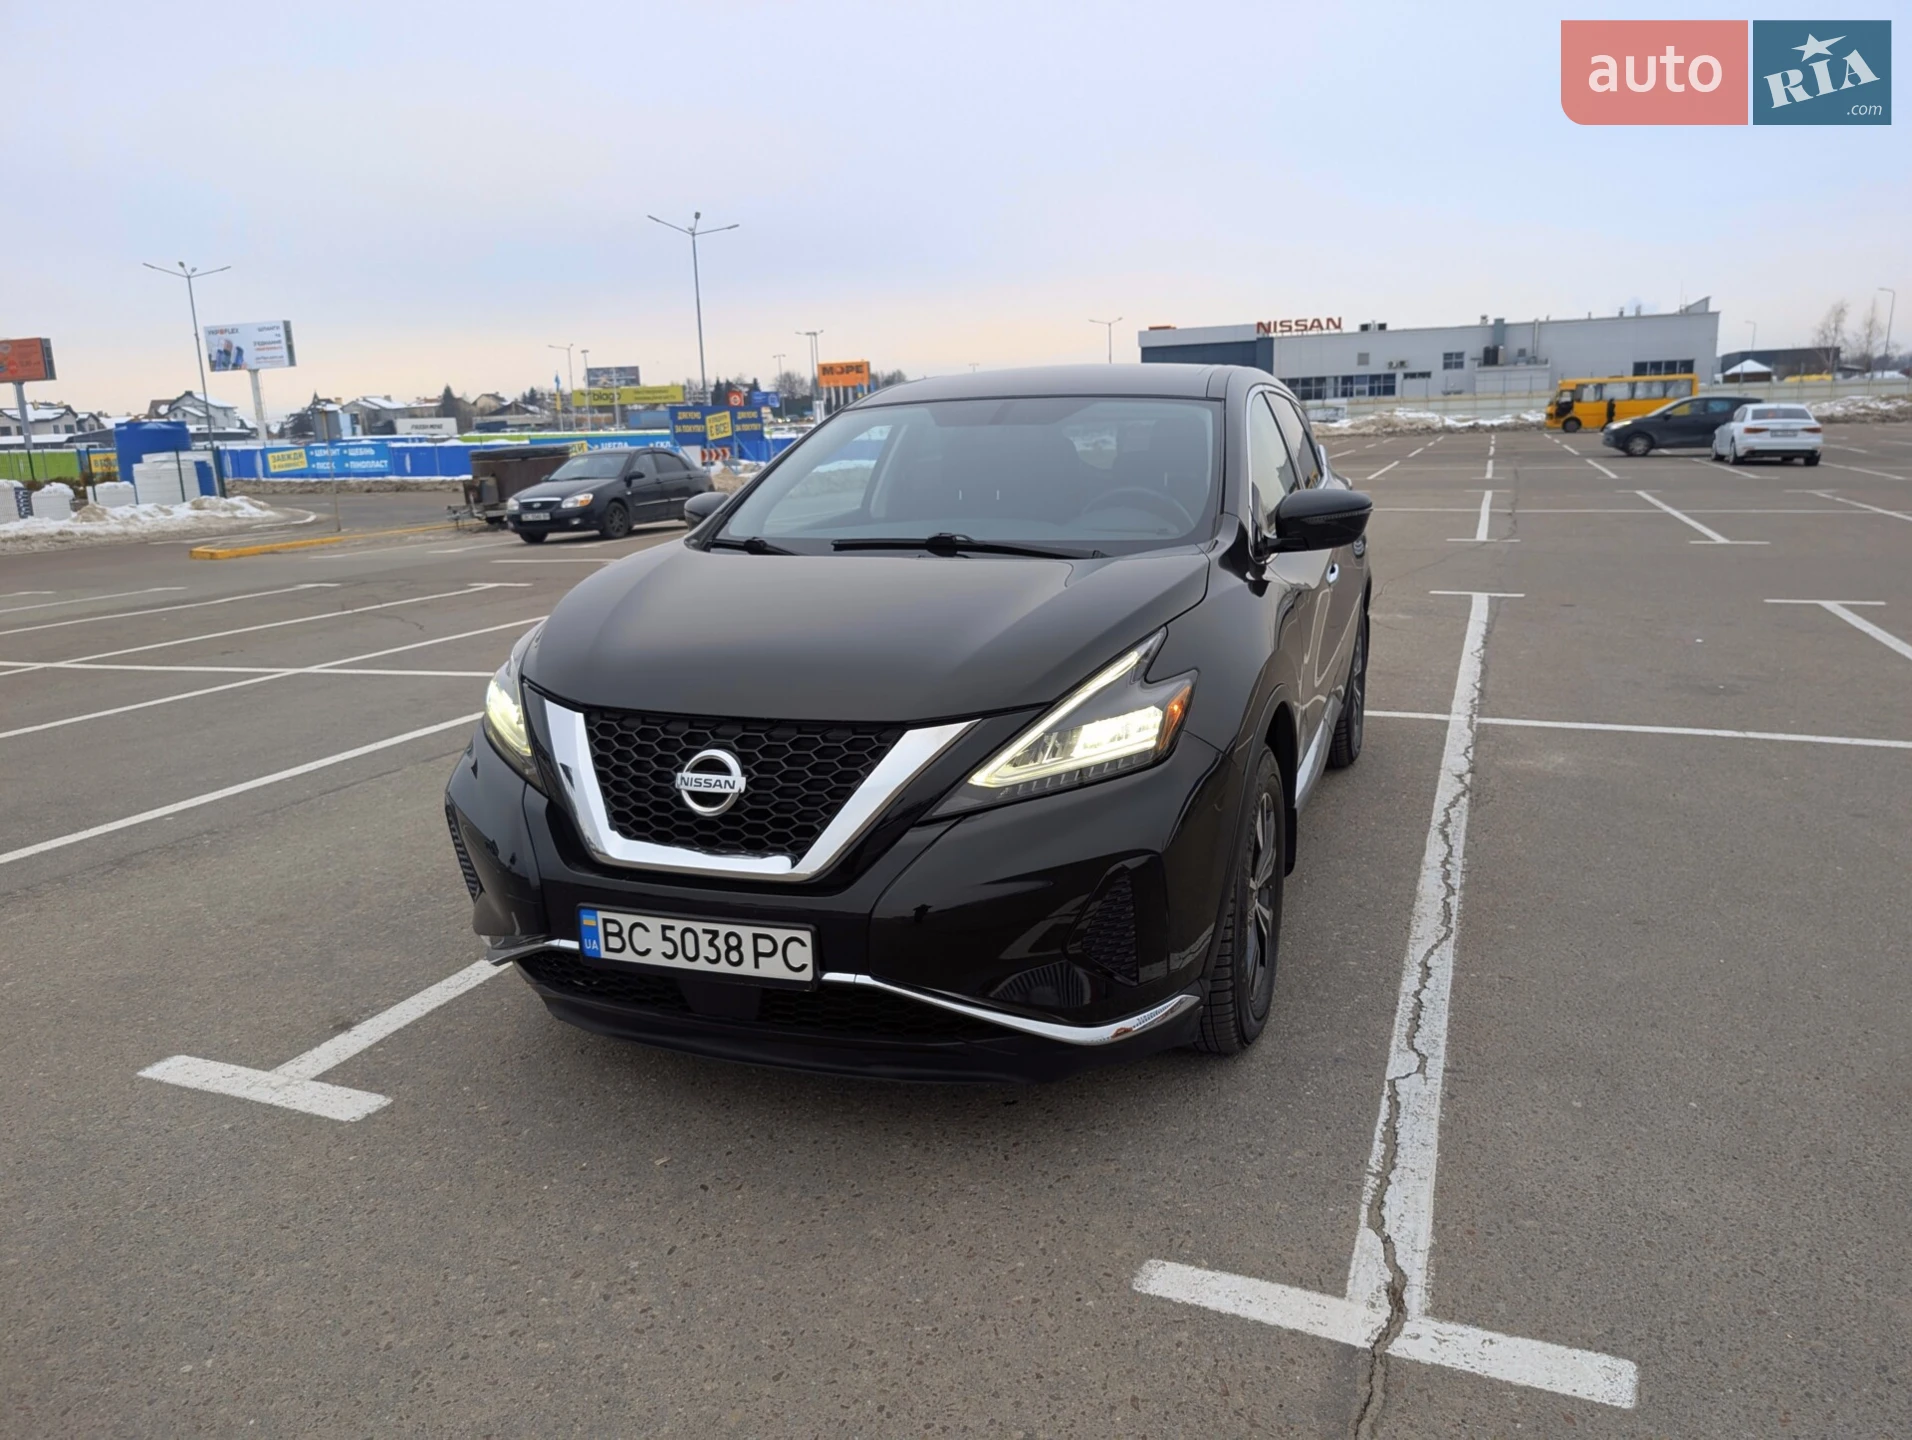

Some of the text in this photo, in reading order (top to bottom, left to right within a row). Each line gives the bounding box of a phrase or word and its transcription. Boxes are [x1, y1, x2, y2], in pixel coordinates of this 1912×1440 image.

[1256, 316, 1342, 334] NISSAN
[680, 776, 736, 790] NISSAN
[584, 938, 599, 950] UA
[602, 917, 808, 973] BC 5038 PC
